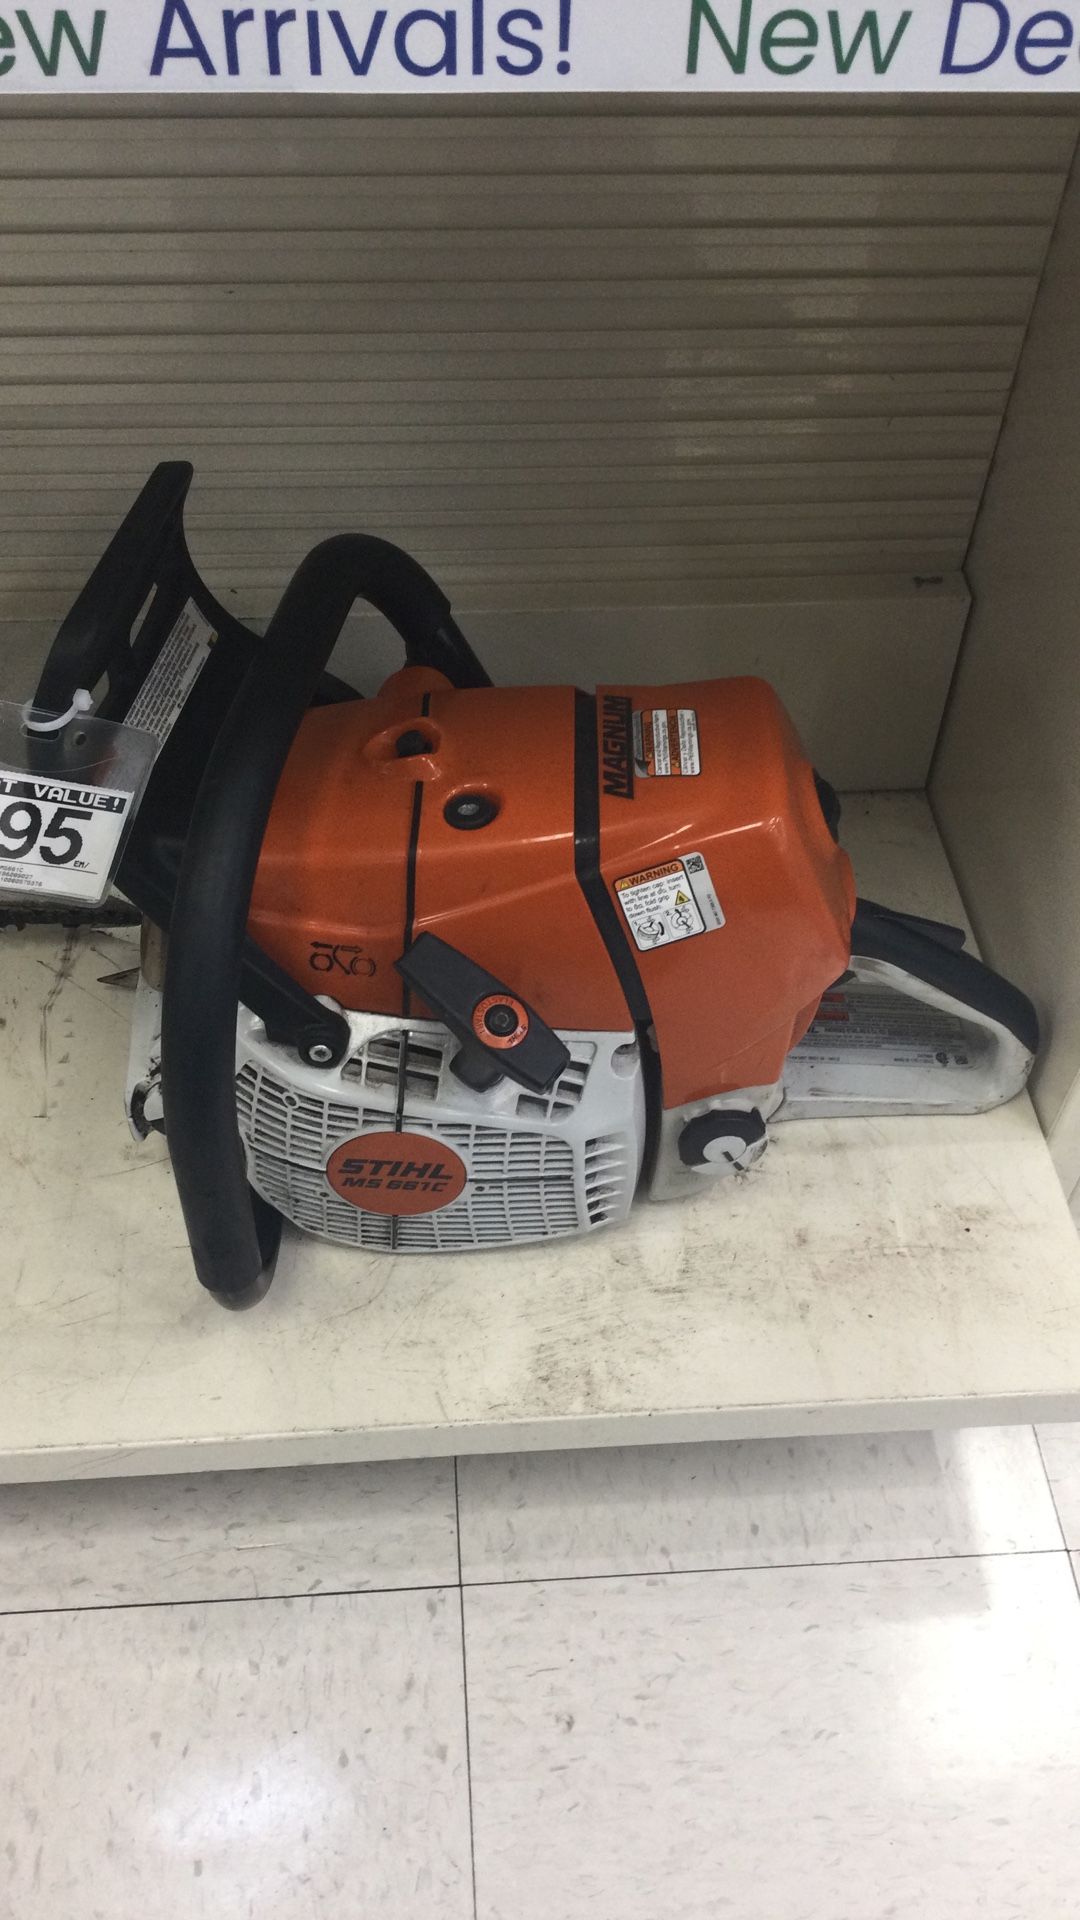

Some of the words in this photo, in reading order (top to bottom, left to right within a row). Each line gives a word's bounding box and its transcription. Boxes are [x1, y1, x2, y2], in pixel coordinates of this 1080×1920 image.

[150, 0, 572, 76] Arrivals!
[686, 0, 913, 75] New
[940, 0, 1080, 75] De
[603, 695, 634, 800] MAGNUM
[0, 779, 18, 793] T
[34, 784, 120, 811] VALUE!
[0, 801, 93, 865] 95
[628, 863, 679, 886] WARNING
[667, 875, 684, 884] insert
[338, 1159, 452, 1180] STIHL
[342, 1178, 382, 1188] MS
[386, 1180, 448, 1192] 661C
